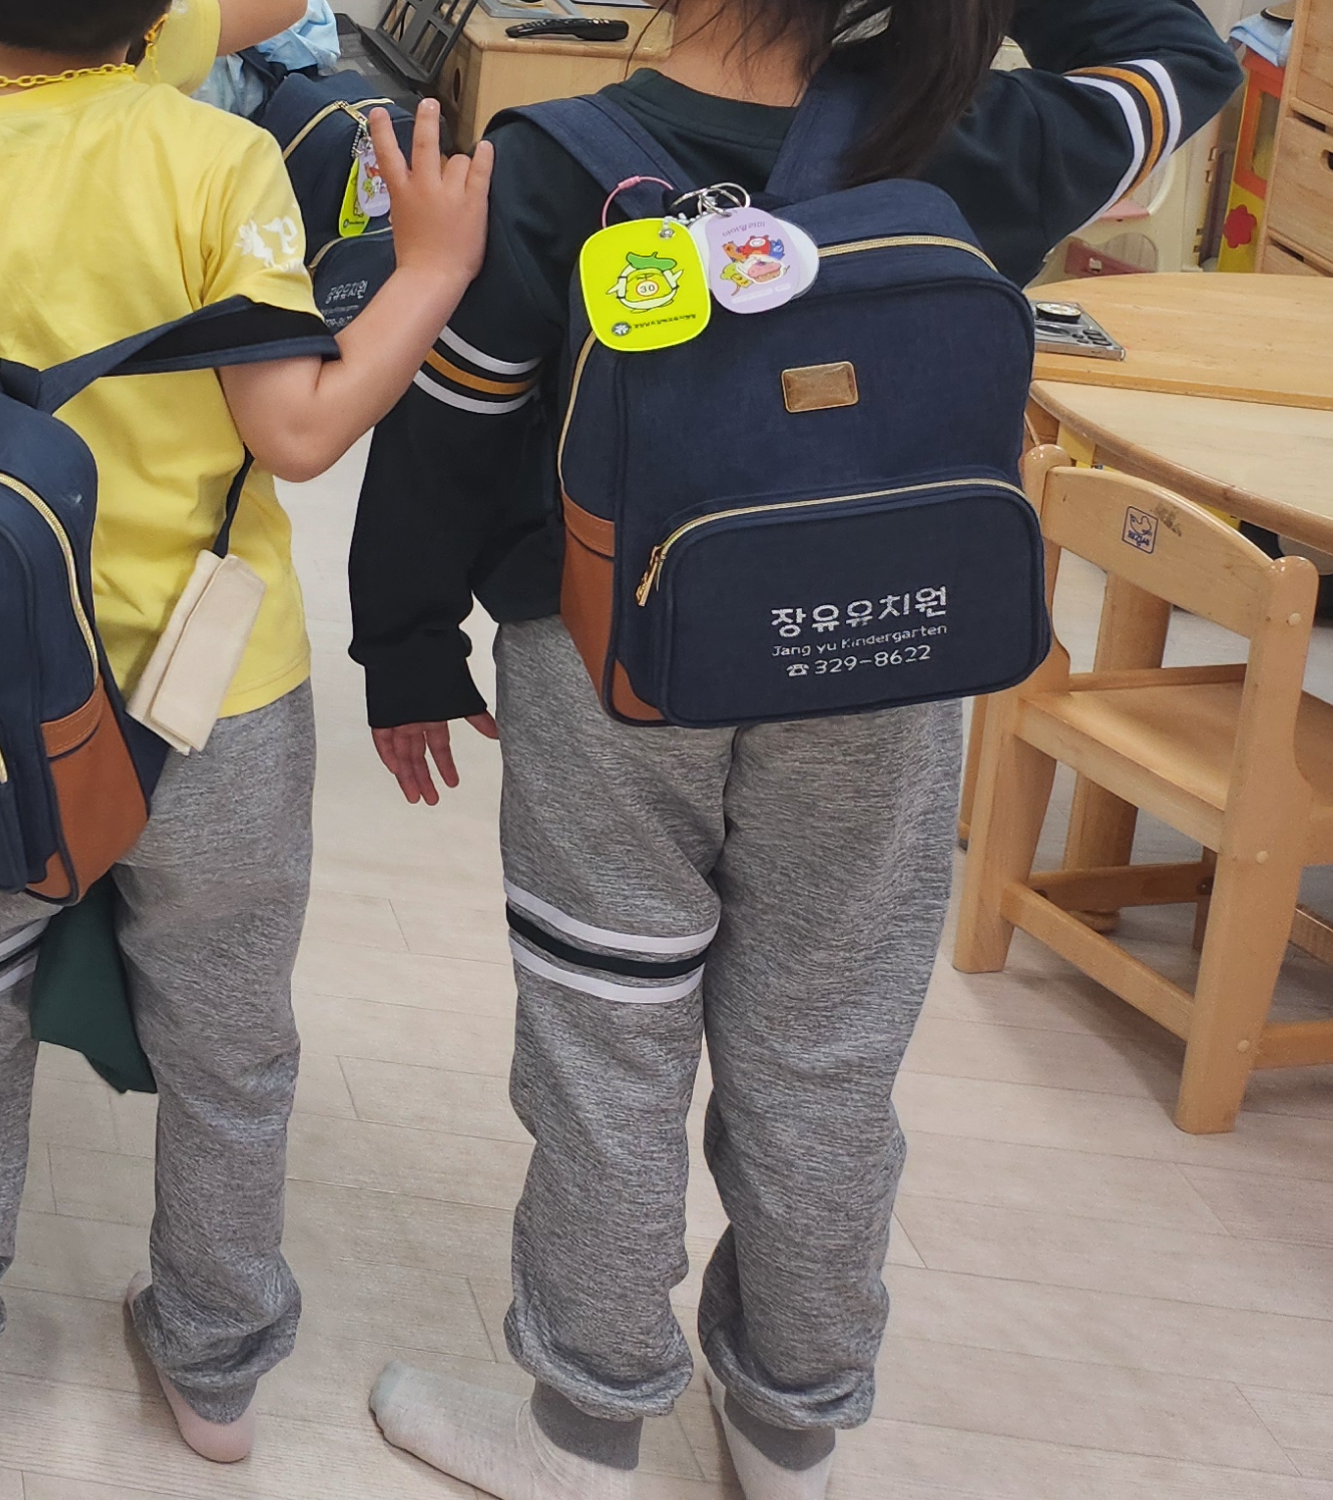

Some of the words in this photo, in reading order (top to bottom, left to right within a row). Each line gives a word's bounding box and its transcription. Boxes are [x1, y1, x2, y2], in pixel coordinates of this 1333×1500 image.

[639, 284, 655, 292] 30
[771, 585, 947, 638] 장유유치원
[771, 645, 811, 657] Jang
[816, 644, 837, 654] yu
[841, 624, 947, 649] Kindergarten
[814, 644, 931, 674] 329-8622
